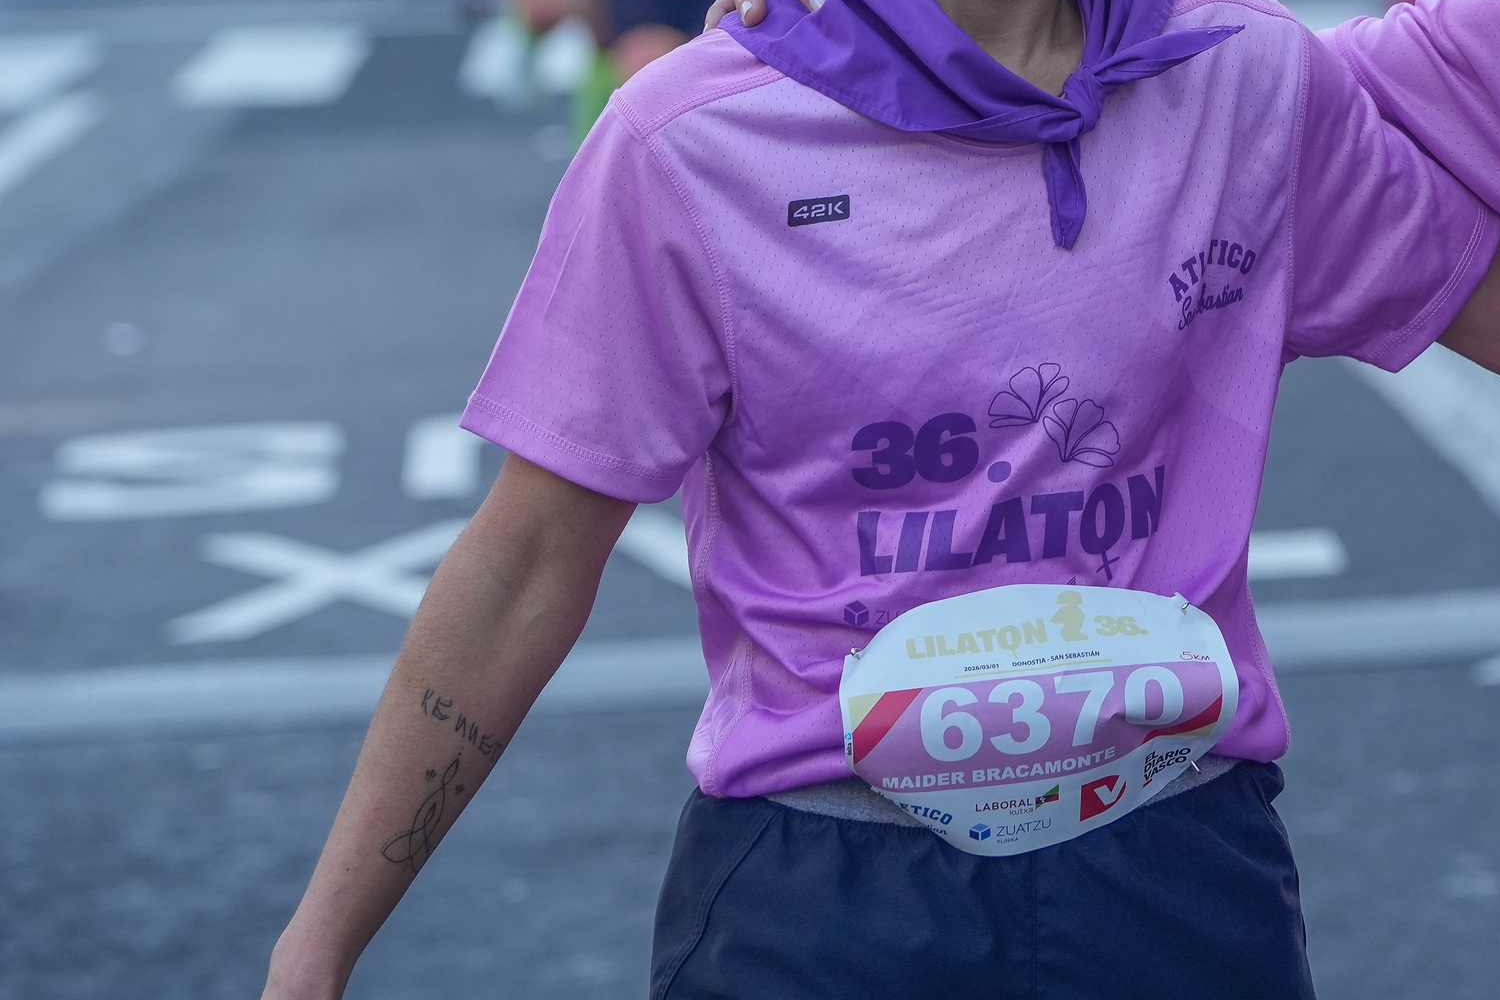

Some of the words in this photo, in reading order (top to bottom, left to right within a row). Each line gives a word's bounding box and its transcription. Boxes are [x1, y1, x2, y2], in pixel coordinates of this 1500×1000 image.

[793, 200, 844, 219] 42K
[851, 412, 1012, 490] 36.
[856, 465, 1166, 581] LILATON
[905, 618, 1048, 660] LILATON
[1093, 615, 1149, 637] 36.
[963, 663, 1000, 672] 2026/03/01
[1011, 657, 1047, 667] DONOSTIA
[1050, 654, 1064, 662] SAN
[1065, 650, 1100, 660] SEBASTIÁN
[920, 665, 1184, 762] 6370
[881, 771, 966, 790] MAIDER
[972, 746, 1116, 784] BRACAMONTE
[1143, 747, 1192, 774] DIARIO
[1143, 755, 1187, 781] VASCO
[1144, 750, 1159, 764] EL
[975, 798, 1034, 812] LABORAL
[1009, 807, 1034, 816] kutxa
[996, 818, 1052, 837] ZUATZU
